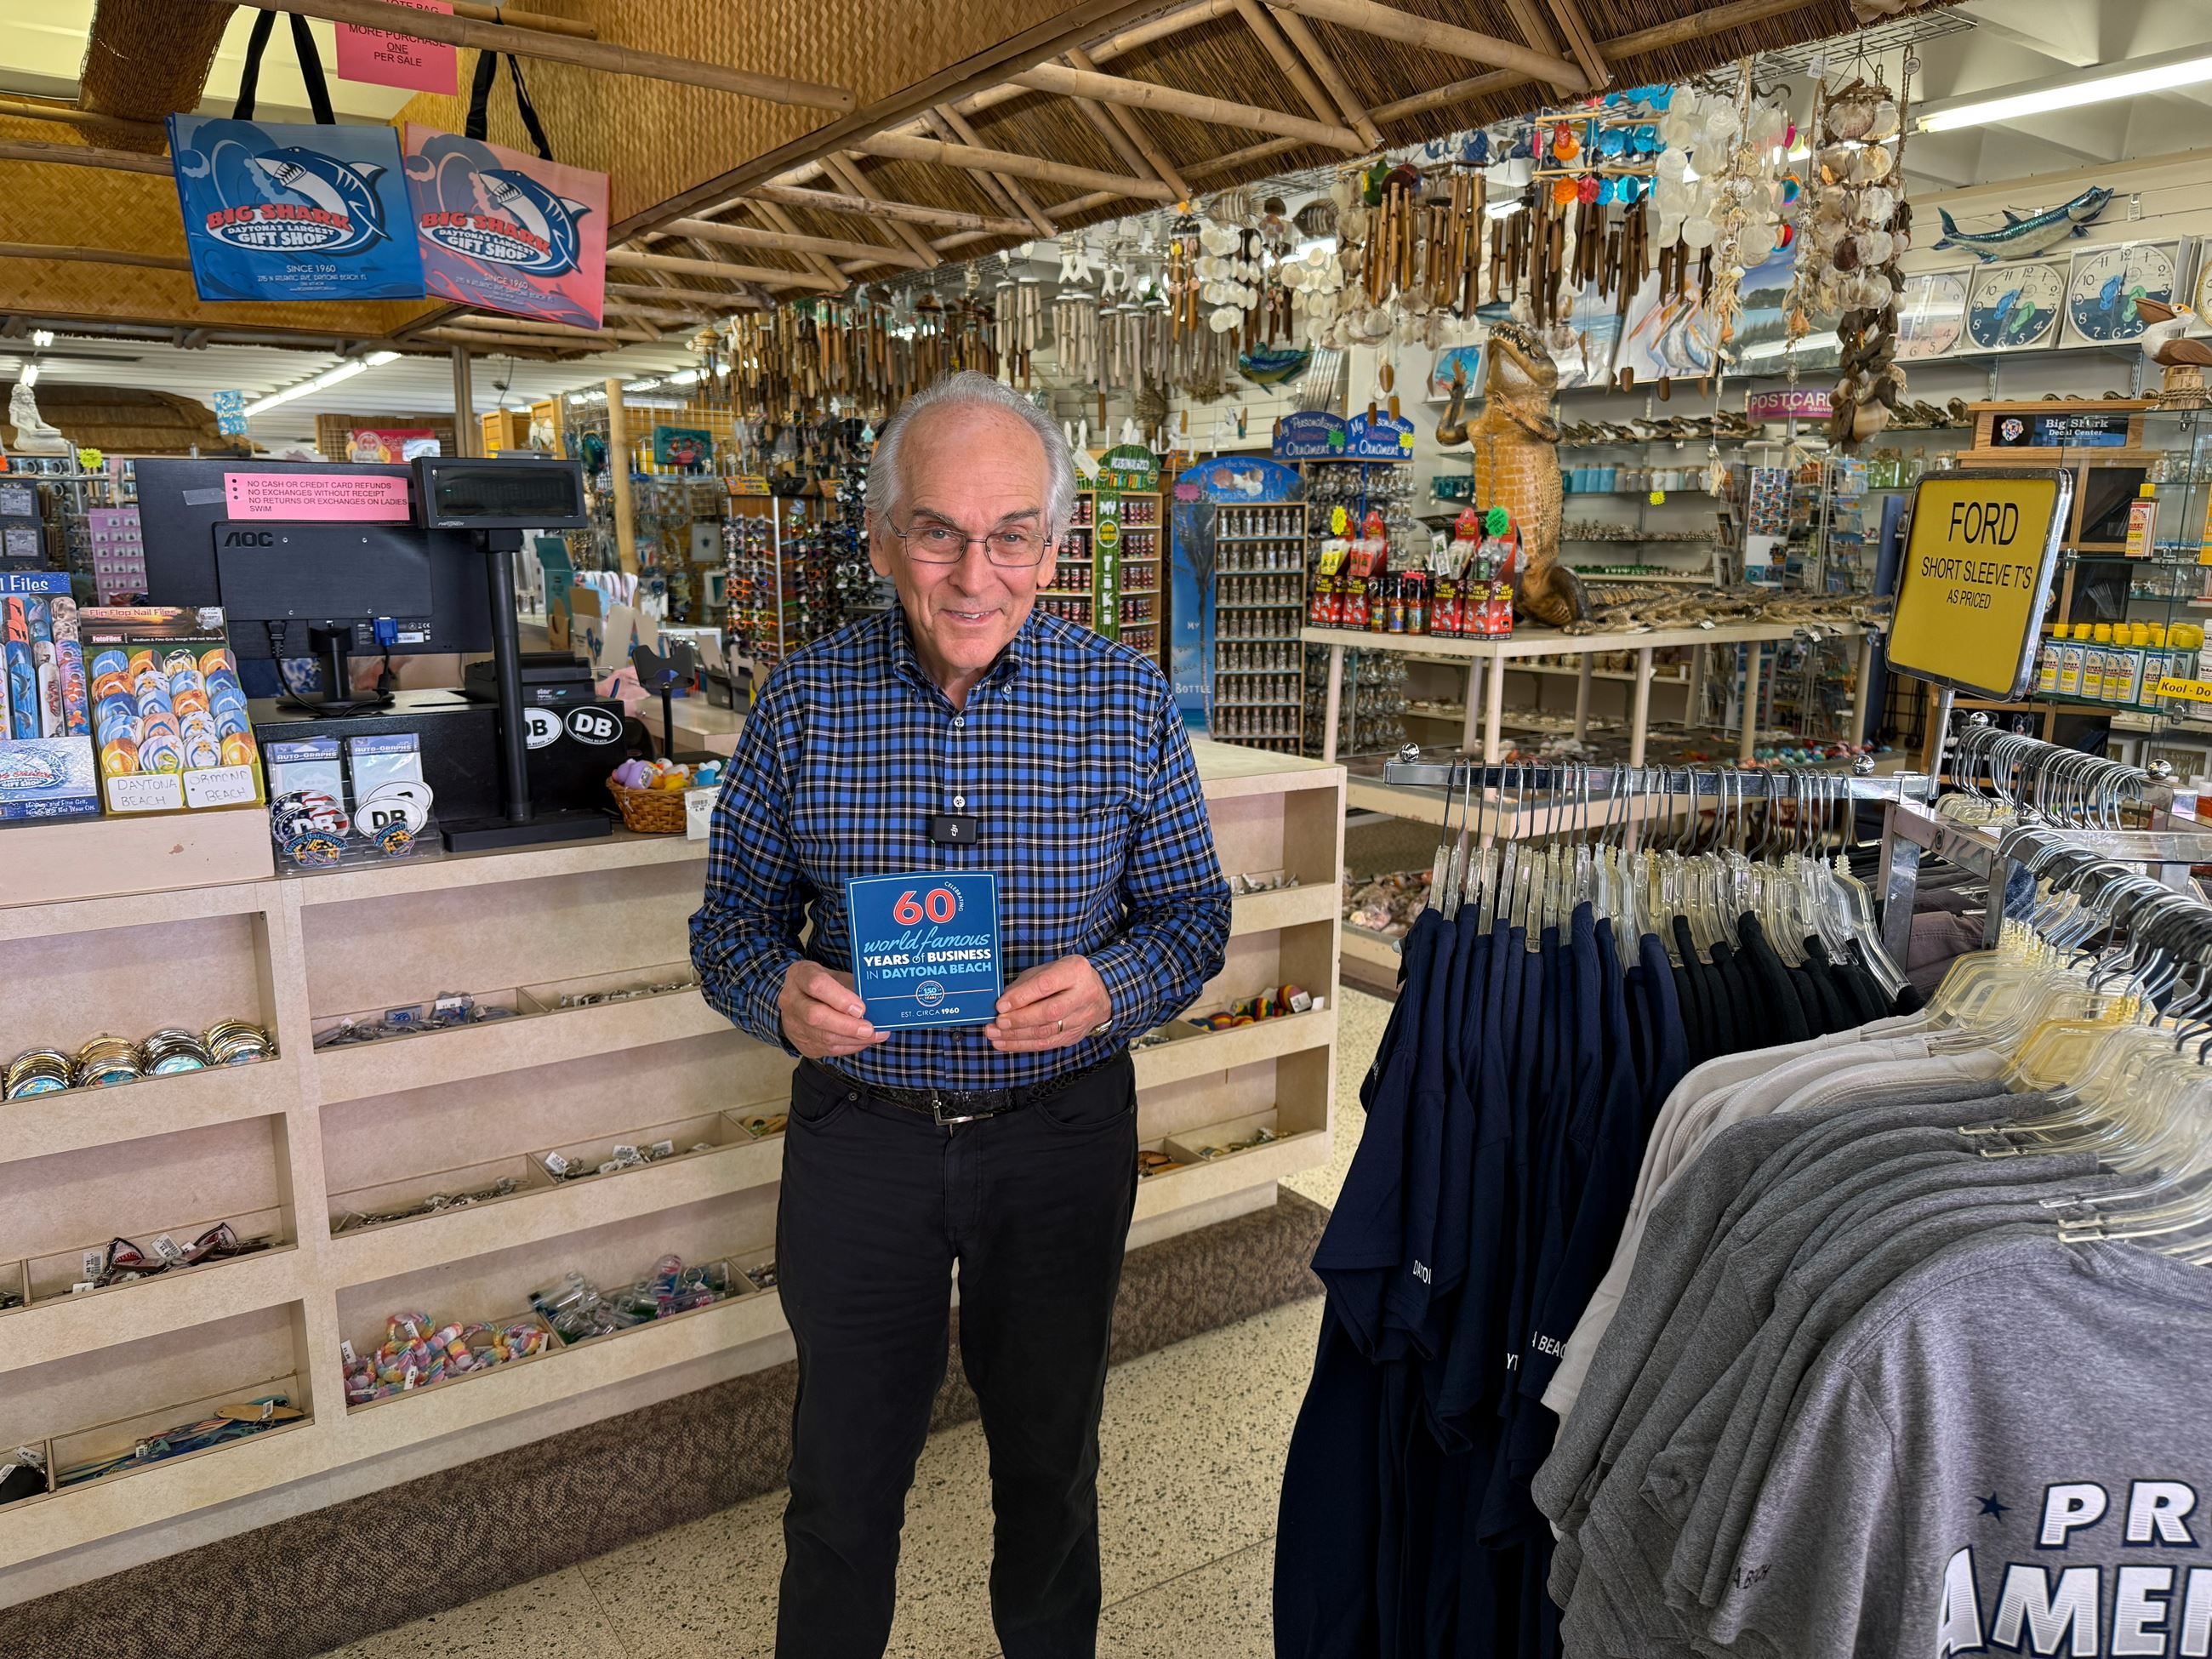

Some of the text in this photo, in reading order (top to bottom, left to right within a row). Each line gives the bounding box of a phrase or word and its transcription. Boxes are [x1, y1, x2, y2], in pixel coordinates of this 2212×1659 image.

[349, 24, 446, 48] MORE PURCHASE
[387, 43, 408, 54] ONE
[374, 52, 422, 66] PER SALE
[207, 203, 353, 231] BIG SHARK
[227, 225, 335, 236] DAYTONA'S LARGEST
[421, 212, 551, 255] BIG SHARK
[238, 231, 328, 246] GIFT SHOP
[439, 229, 535, 255] DAYTONA'S LARGEST
[448, 237, 527, 260] GIFT SHOP
[286, 265, 336, 273] SINCE 1960
[2004, 271, 2014, 281] 11
[2023, 267, 2034, 277] 12
[2158, 265, 2166, 276] 2
[483, 272, 508, 286] SINCE
[510, 277, 529, 290] 1960
[2084, 274, 2095, 286] 10
[1986, 285, 1998, 295] 10
[2161, 283, 2169, 296] 3
[1974, 301, 1984, 312] 9
[2074, 294, 2084, 305] 9
[2047, 303, 2056, 314] 3
[1972, 319, 1981, 330] 8
[2078, 312, 2087, 324] 8
[2033, 321, 2043, 331] 4
[2093, 327, 2101, 337] 7
[2135, 320, 2144, 334] 5
[1981, 334, 1990, 344] 7
[2016, 334, 2026, 345] 5
[2112, 328, 2121, 339] 6
[2045, 419, 2067, 430] Big
[1286, 442, 1330, 456] Ornament
[1359, 440, 1400, 456] Ornament
[1947, 502, 2019, 545] FORD
[225, 532, 274, 547] AOC
[1921, 556, 2032, 590] SHORT SLEEVE T'S
[10, 575, 48, 591] Files
[1947, 590, 1992, 610] AS PRICED
[110, 609, 131, 618] Flop
[2161, 681, 2211, 697] Kool Do
[575, 713, 613, 738] DB
[117, 778, 178, 791] DAYTONA
[189, 770, 248, 785] ORMOND
[122, 795, 166, 807] BEACH
[205, 787, 245, 802] BEACH
[293, 814, 337, 835] DB
[372, 810, 408, 830] DB
[944, 881, 964, 912] CELEBRATING
[893, 888, 955, 926] 60
[864, 926, 991, 961] world famous
[864, 949, 991, 967] YEARS of BUSINESS
[866, 961, 992, 980] IN DAYTONA BEACH
